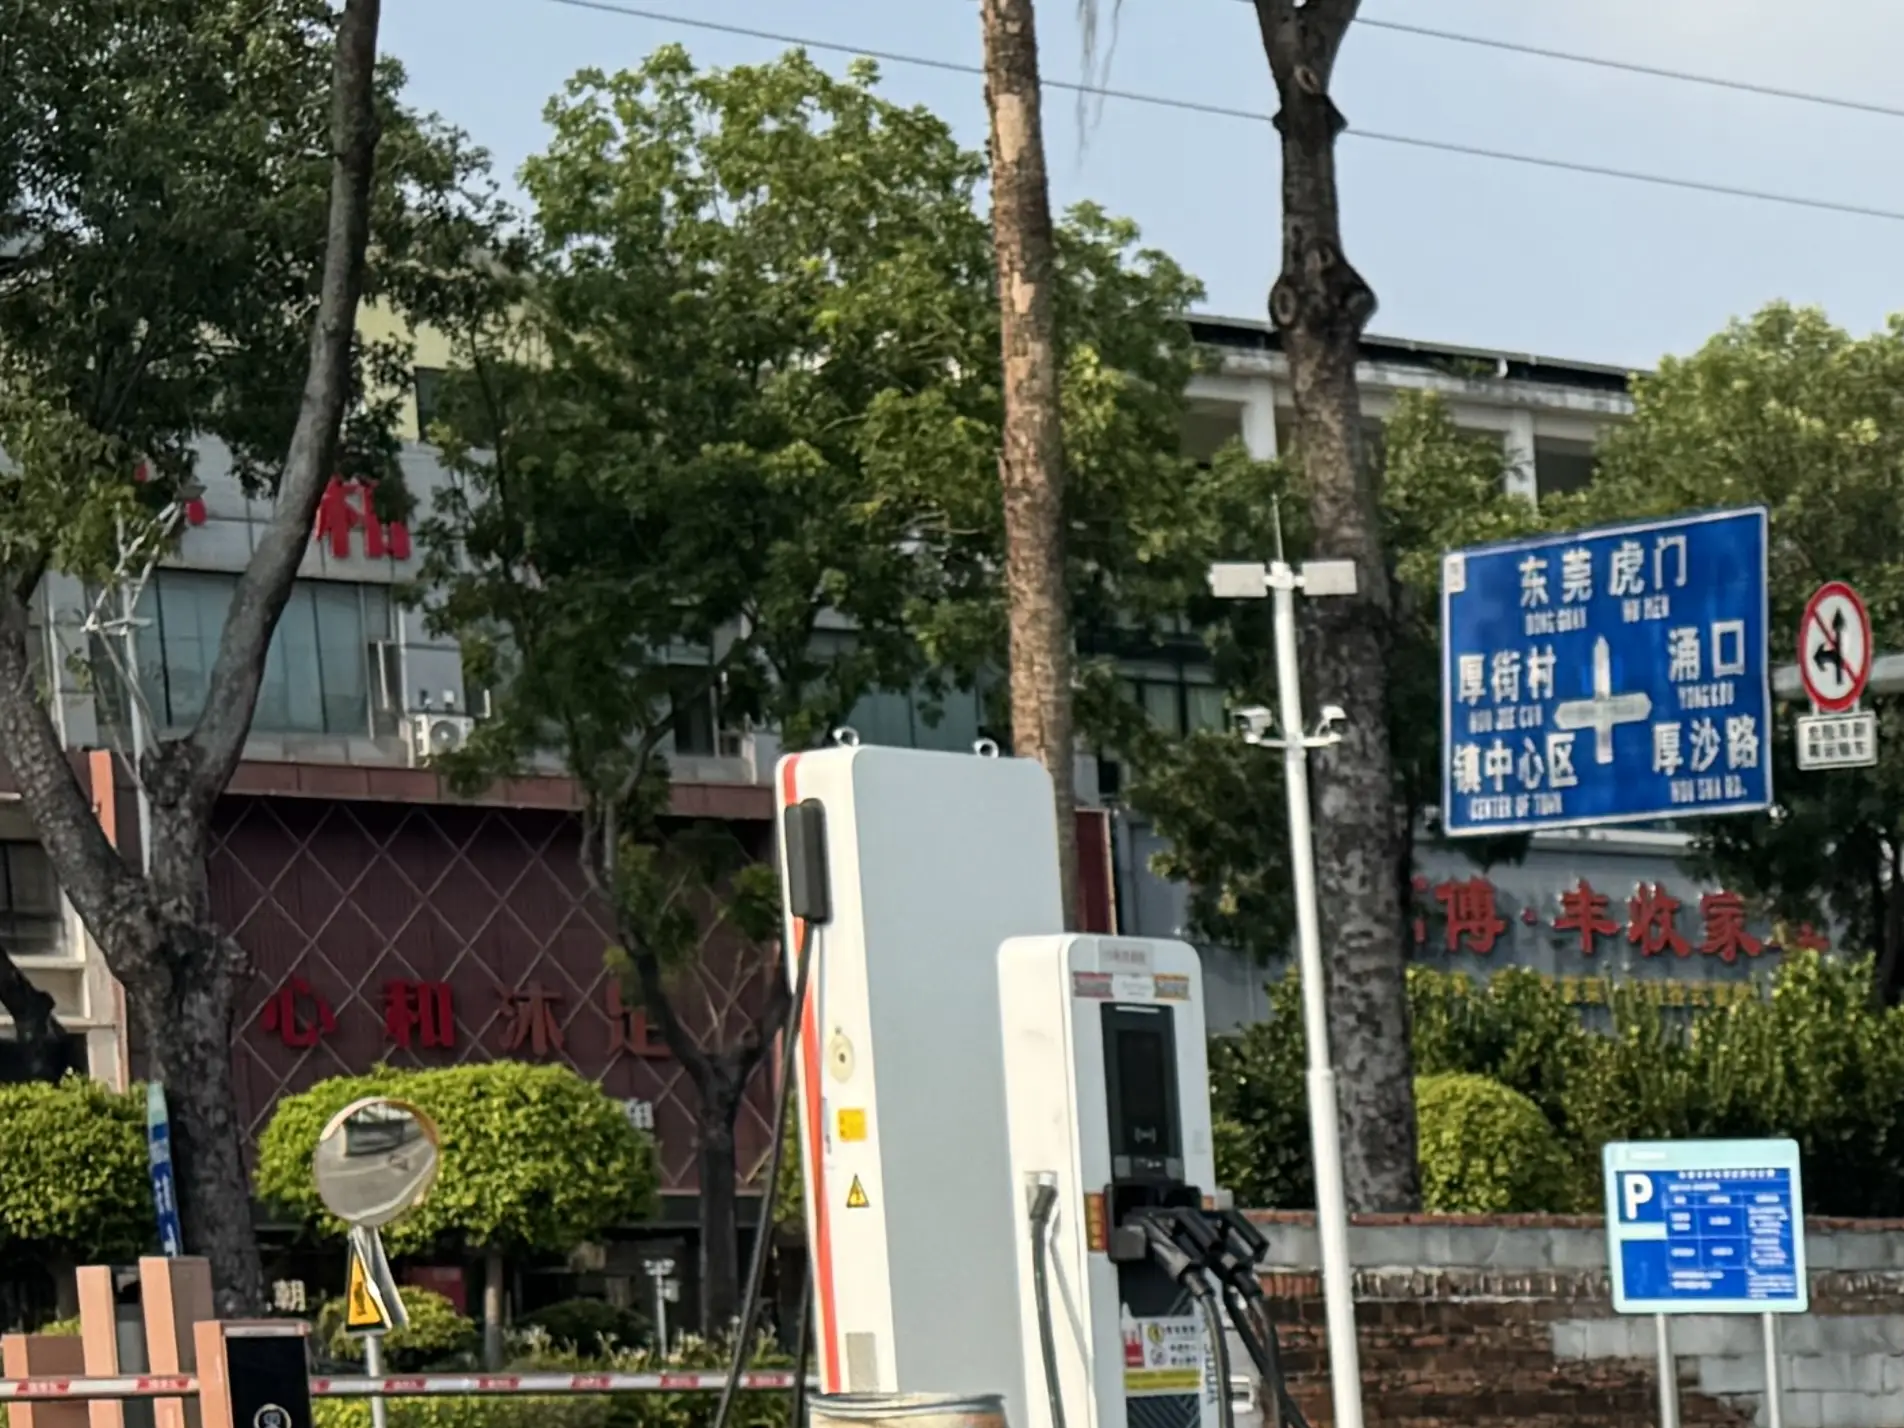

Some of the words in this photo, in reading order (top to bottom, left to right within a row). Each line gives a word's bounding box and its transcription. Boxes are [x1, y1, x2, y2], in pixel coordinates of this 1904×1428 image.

[1519, 535, 1687, 608] 东莞虎门
[1457, 643, 1557, 706] 厚街村
[1668, 620, 1744, 682] 涌口
[1453, 732, 1578, 794] 镇中心区
[1652, 713, 1759, 776] 厚沙路
[1624, 1173, 1653, 1220] P
